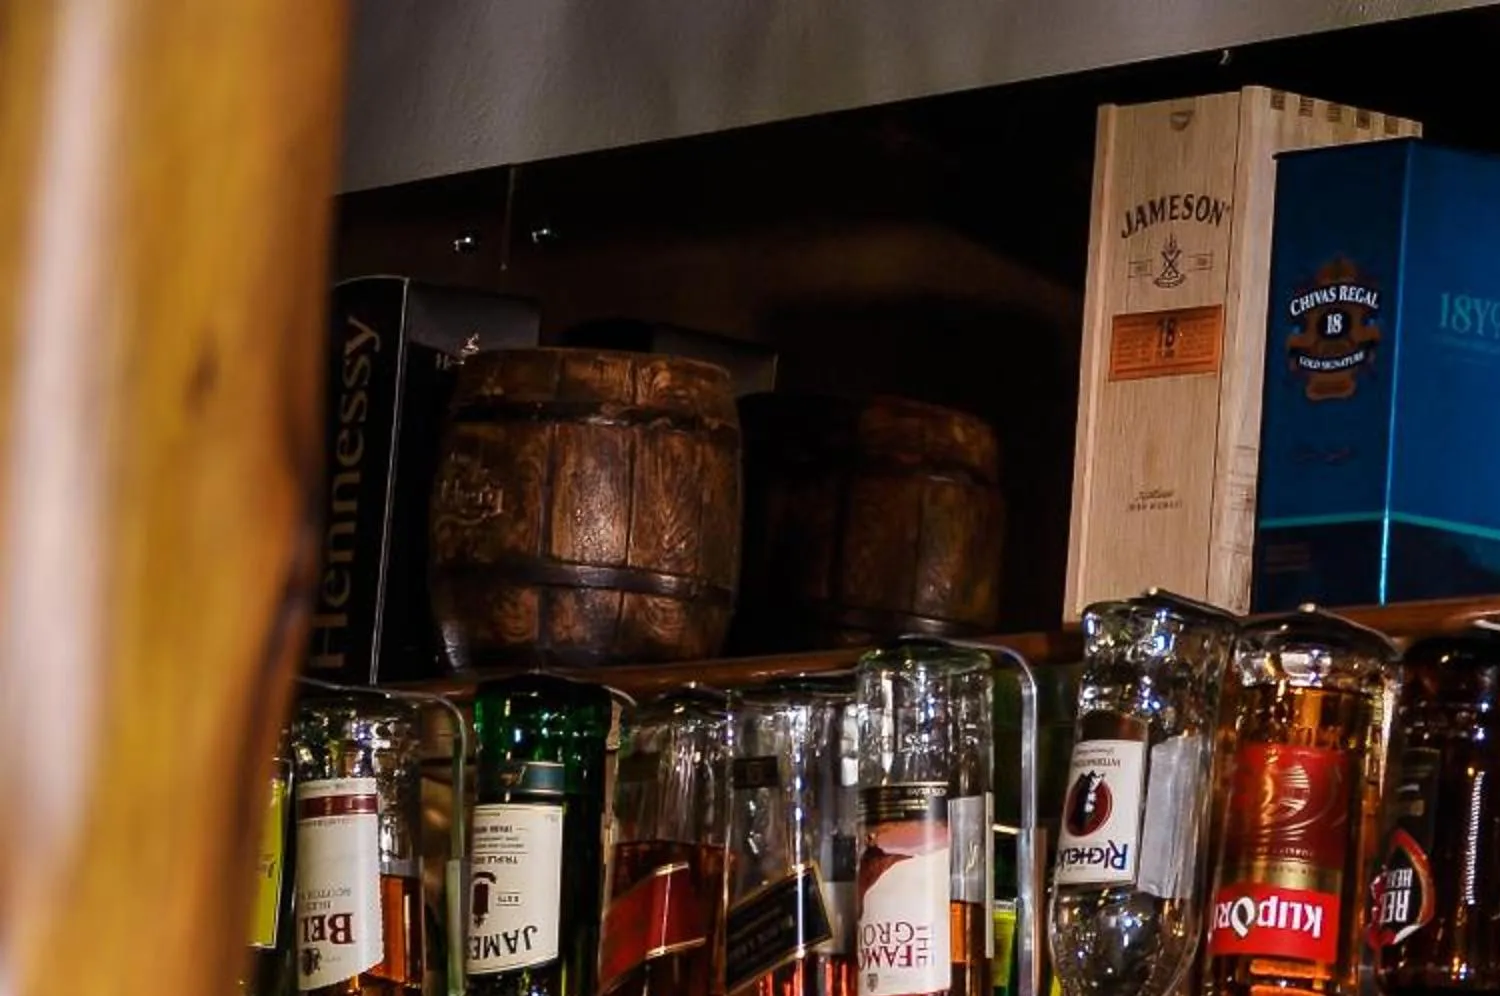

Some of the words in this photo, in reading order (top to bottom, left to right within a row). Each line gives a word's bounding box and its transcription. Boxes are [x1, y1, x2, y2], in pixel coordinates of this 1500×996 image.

[1121, 193, 1226, 239] JAMESON
[1290, 286, 1338, 316] CHIVAS
[1339, 285, 1380, 309] REGAL
[1326, 313, 1343, 335] 18
[308, 315, 381, 668] Hennessy
